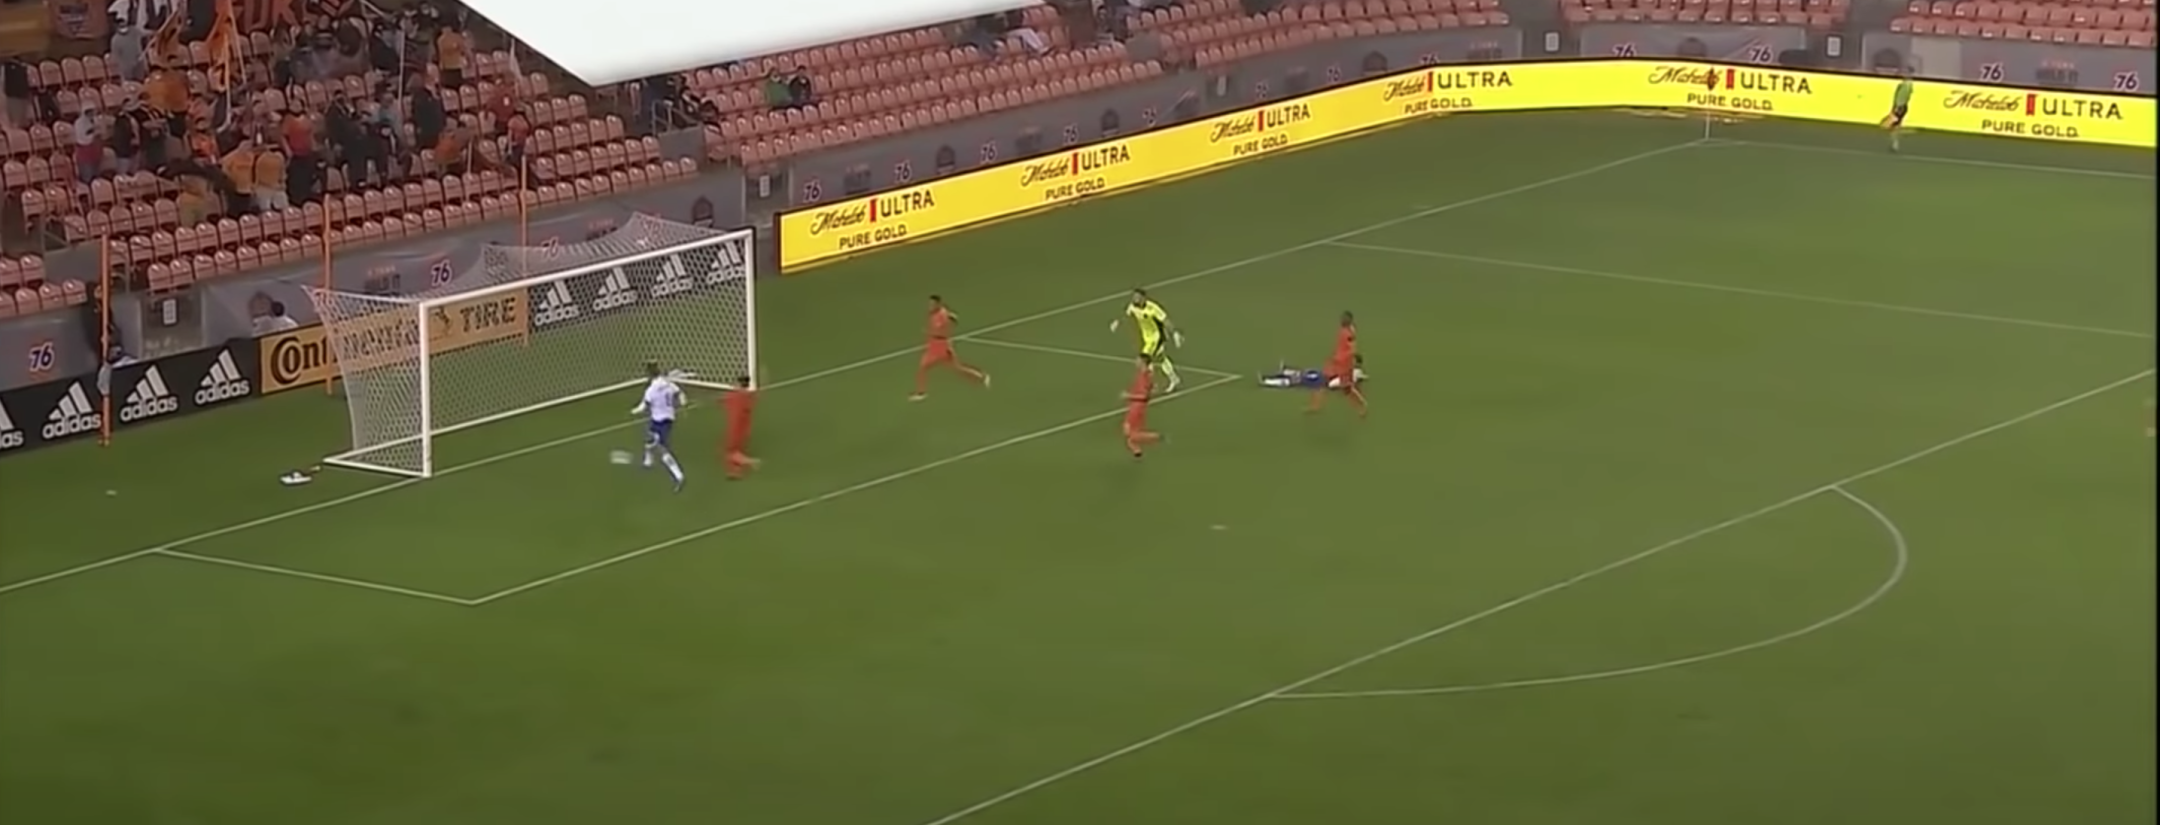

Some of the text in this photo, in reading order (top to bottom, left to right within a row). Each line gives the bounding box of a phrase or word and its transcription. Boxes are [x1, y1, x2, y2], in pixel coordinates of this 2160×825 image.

[1749, 46, 1773, 64] 76
[1438, 71, 1513, 89] ULTRA
[1740, 72, 1812, 94] ULTRA
[1980, 62, 2004, 82] 76
[2114, 71, 2140, 92] 76
[1404, 100, 1428, 114] PURE
[1687, 93, 1727, 107] PURE
[2042, 98, 2122, 120] ULTRA
[1267, 103, 1311, 128] ULTRA
[1981, 119, 2025, 134] PURE
[1081, 144, 1131, 171] ULTRA
[1233, 140, 1259, 156] PURE
[803, 178, 823, 204] 76
[1045, 184, 1074, 200] PURE
[880, 189, 935, 218] ULTRA
[839, 231, 872, 249] PURE
[430, 259, 453, 287] 76
[459, 297, 517, 333] TIRE
[29, 341, 54, 373] 76
[194, 378, 251, 406] adidas
[120, 396, 179, 422] adidas
[42, 412, 103, 440] adidas
